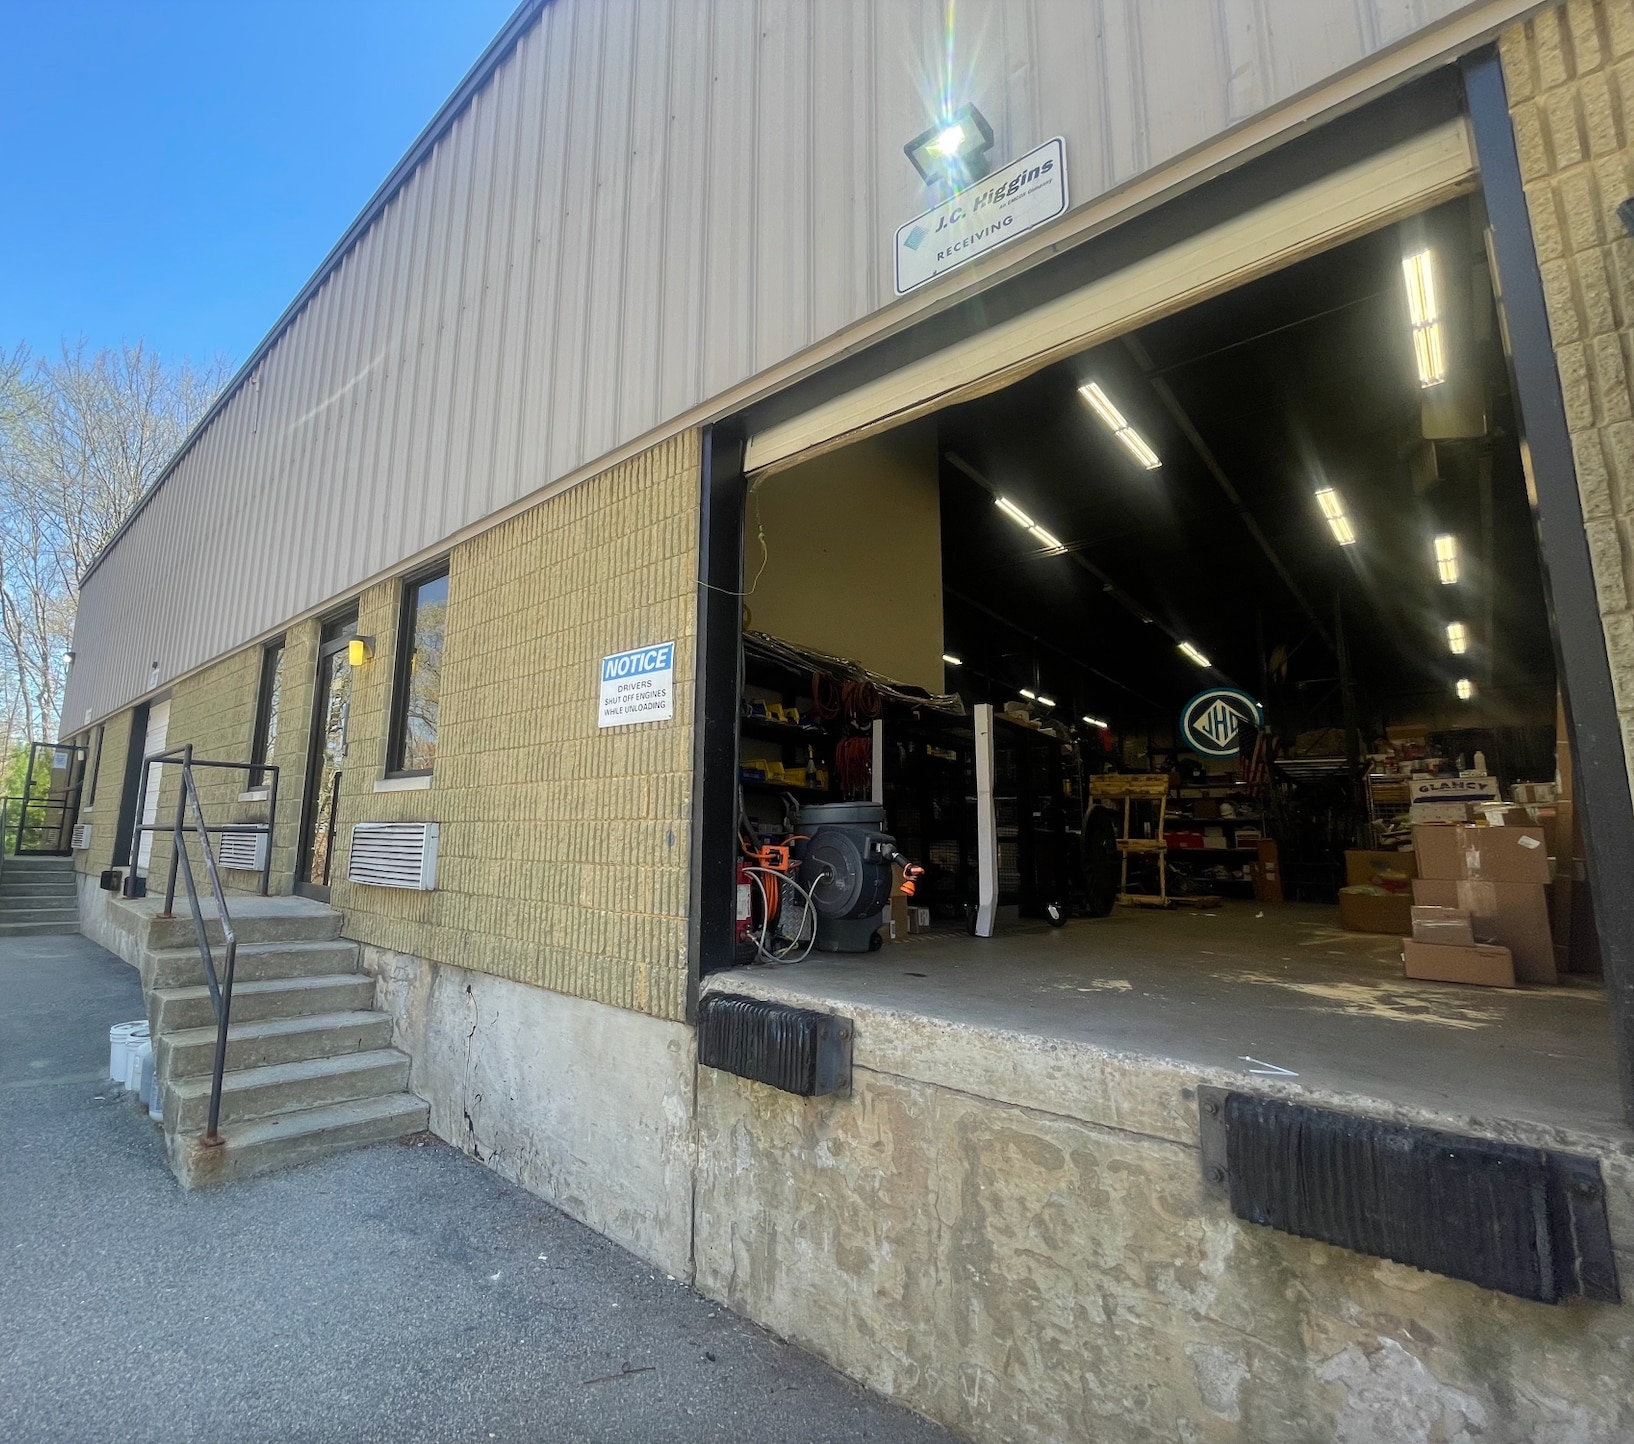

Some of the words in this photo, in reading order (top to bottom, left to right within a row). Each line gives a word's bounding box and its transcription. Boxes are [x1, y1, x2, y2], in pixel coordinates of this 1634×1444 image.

[1028, 178, 1053, 194] Company
[935, 207, 966, 233] J.C.
[973, 159, 1054, 212] Higgins
[937, 215, 1013, 261] RECEIVING
[605, 648, 669, 679] NOTICE
[618, 680, 652, 693] DRIVERS
[604, 696, 621, 706] SHUT
[623, 693, 635, 703] OFF
[636, 688, 667, 701] ENGINES
[604, 706, 623, 716] WHILE
[625, 700, 666, 714] UNLOADING
